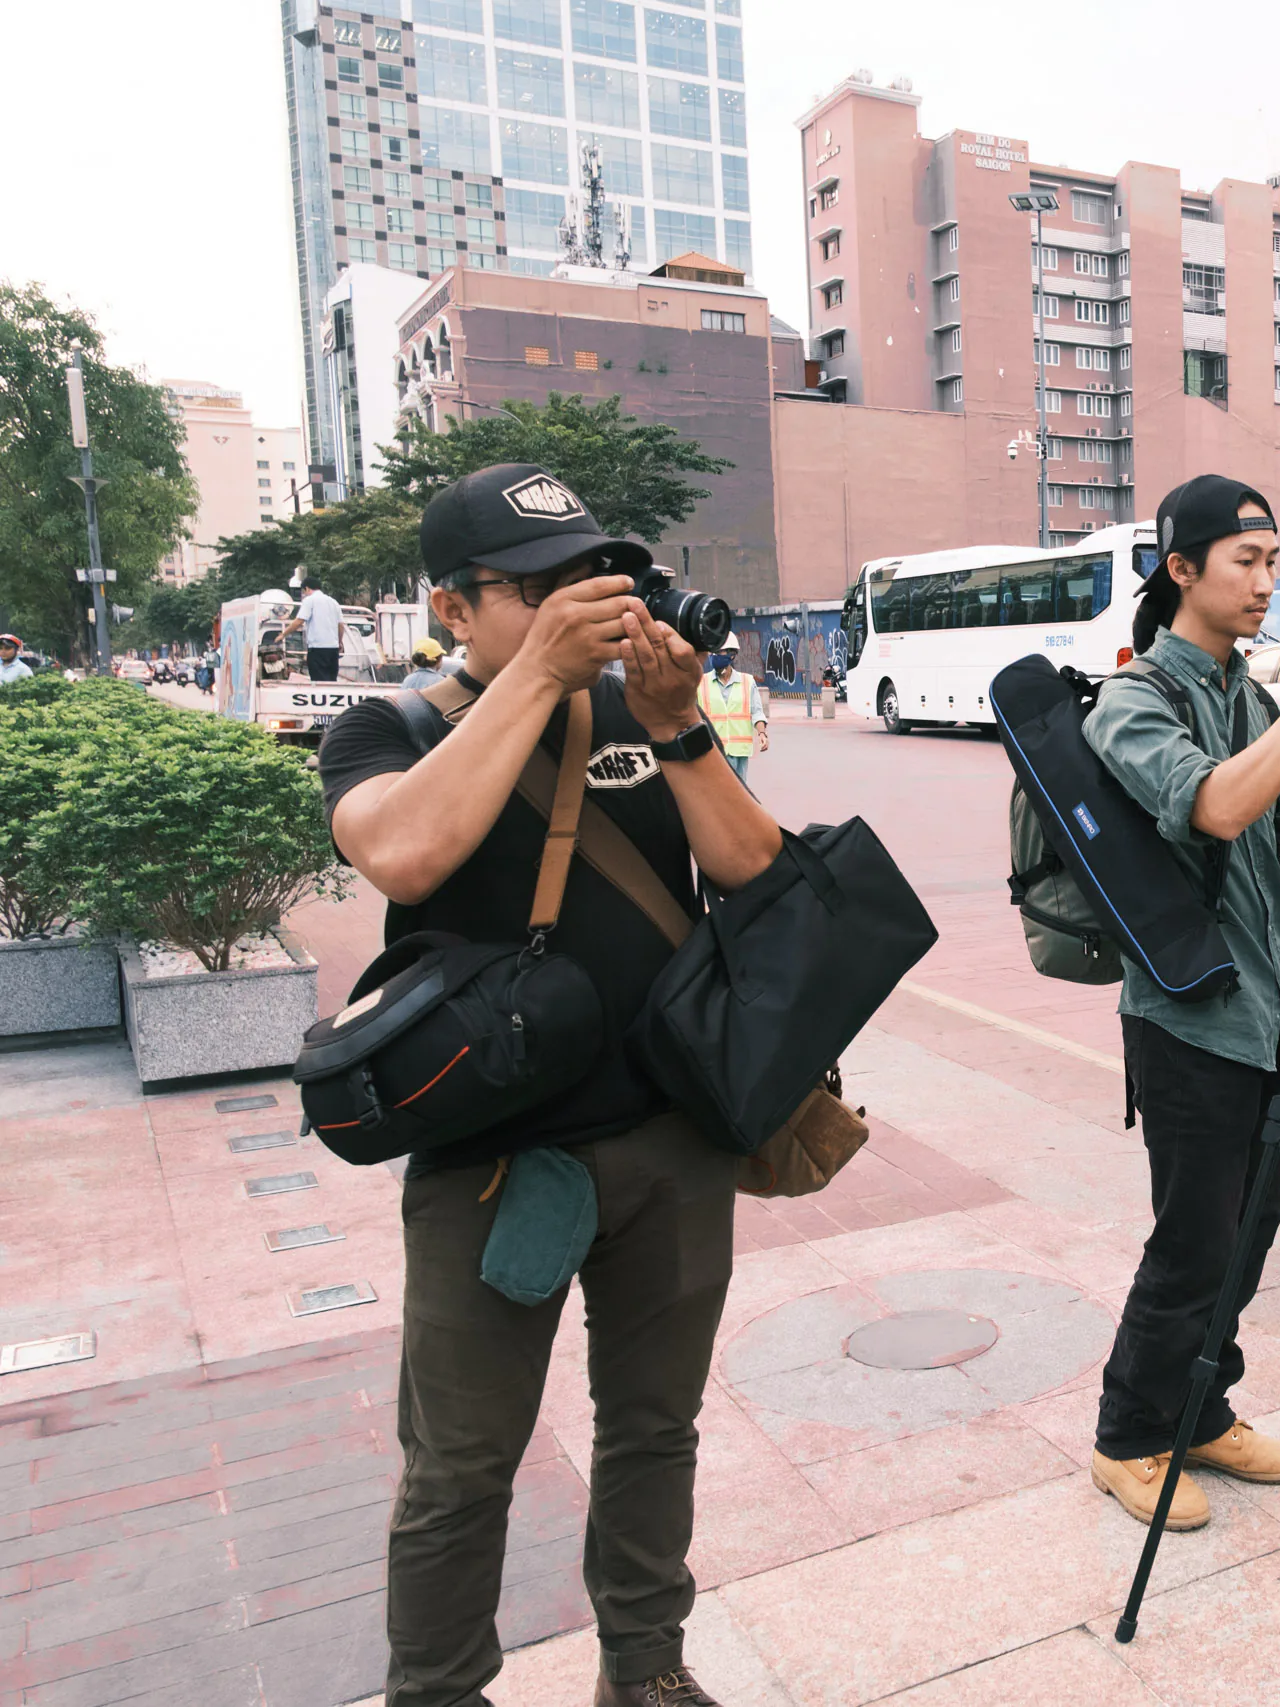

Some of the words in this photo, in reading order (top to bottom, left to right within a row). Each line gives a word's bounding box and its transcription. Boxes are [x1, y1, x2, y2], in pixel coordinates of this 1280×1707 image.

[961, 142, 993, 158] ROYAL
[995, 148, 1027, 164] HOTEL
[975, 157, 1011, 172] SAIGON
[292, 693, 364, 707] SUZU
